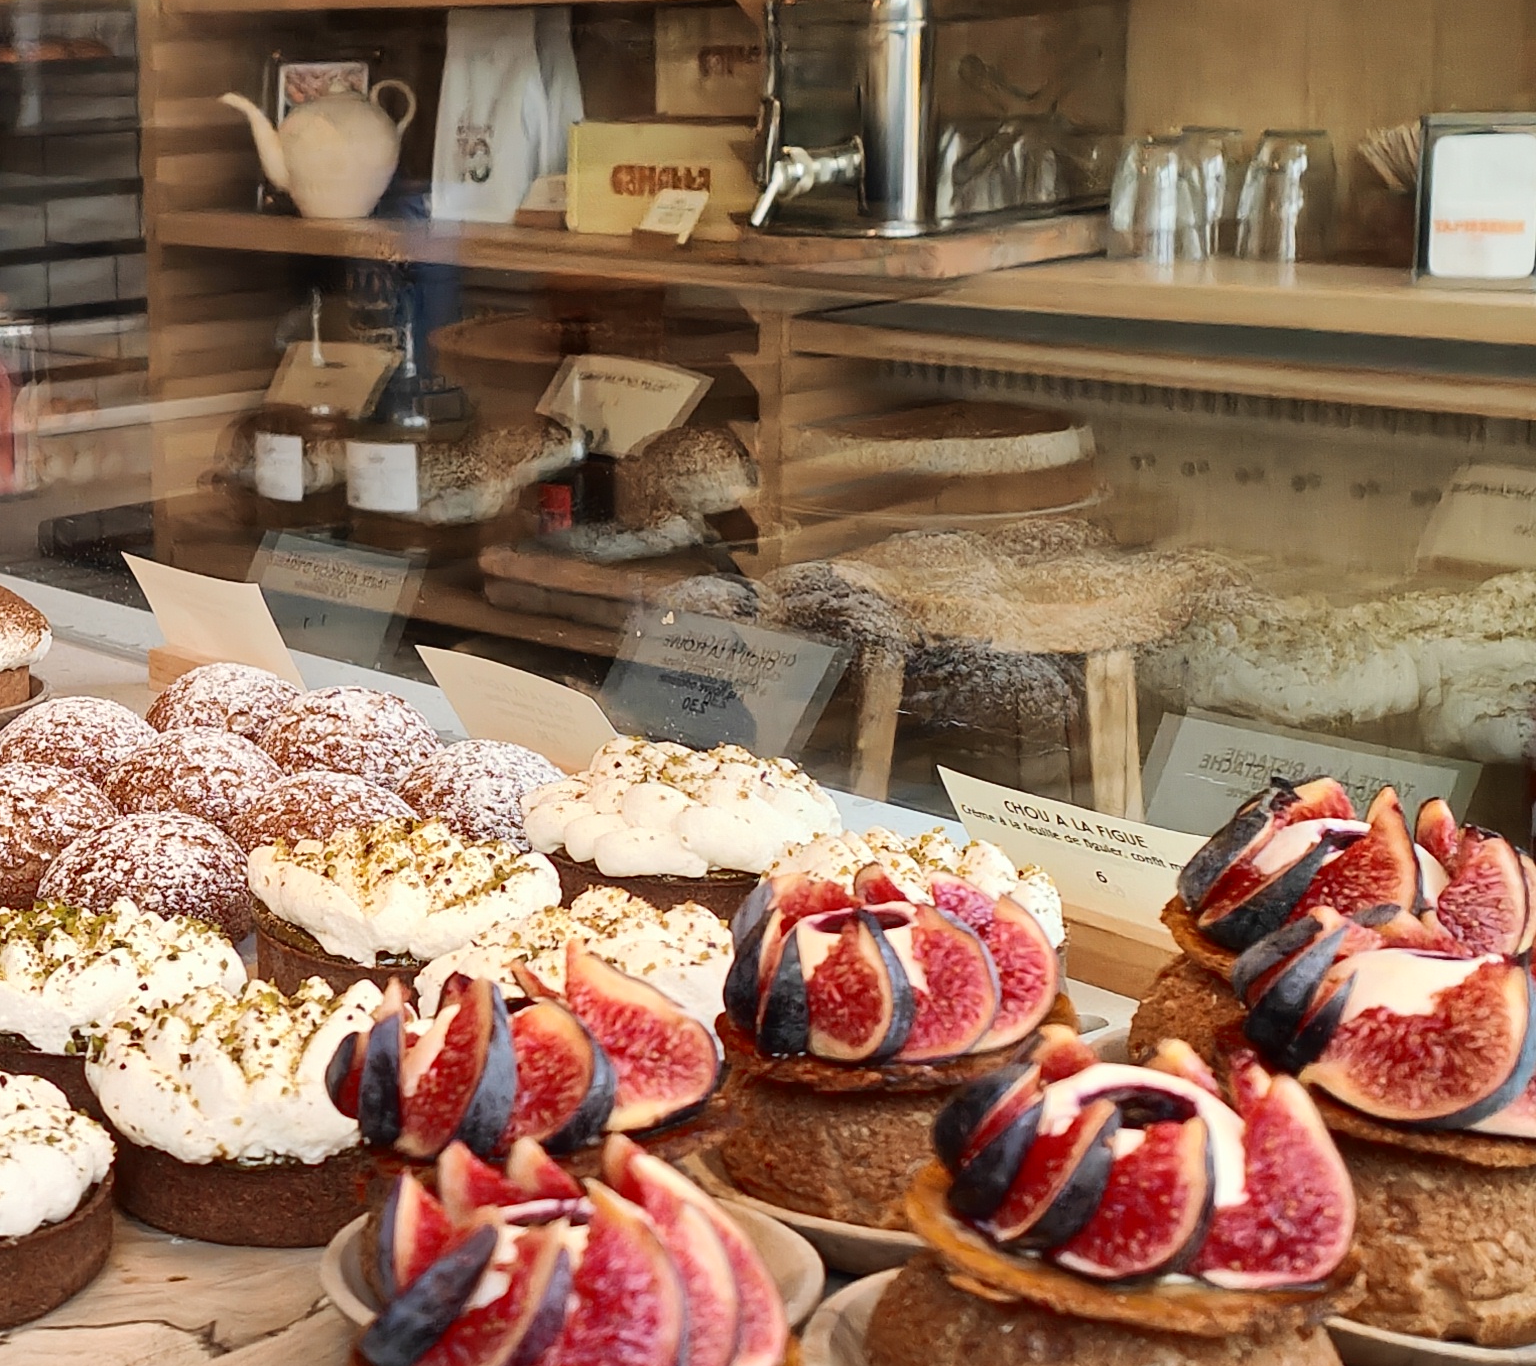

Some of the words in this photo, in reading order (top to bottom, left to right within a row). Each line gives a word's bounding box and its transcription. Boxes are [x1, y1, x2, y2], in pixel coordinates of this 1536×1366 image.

[1003, 800, 1050, 824] CHOU
[1056, 814, 1068, 828] A
[1071, 817, 1095, 835] LA
[1095, 824, 1148, 849] FIGUE
[1009, 817, 1021, 831] la
[1023, 821, 1061, 841] feuille
[1064, 834, 1081, 846] de
